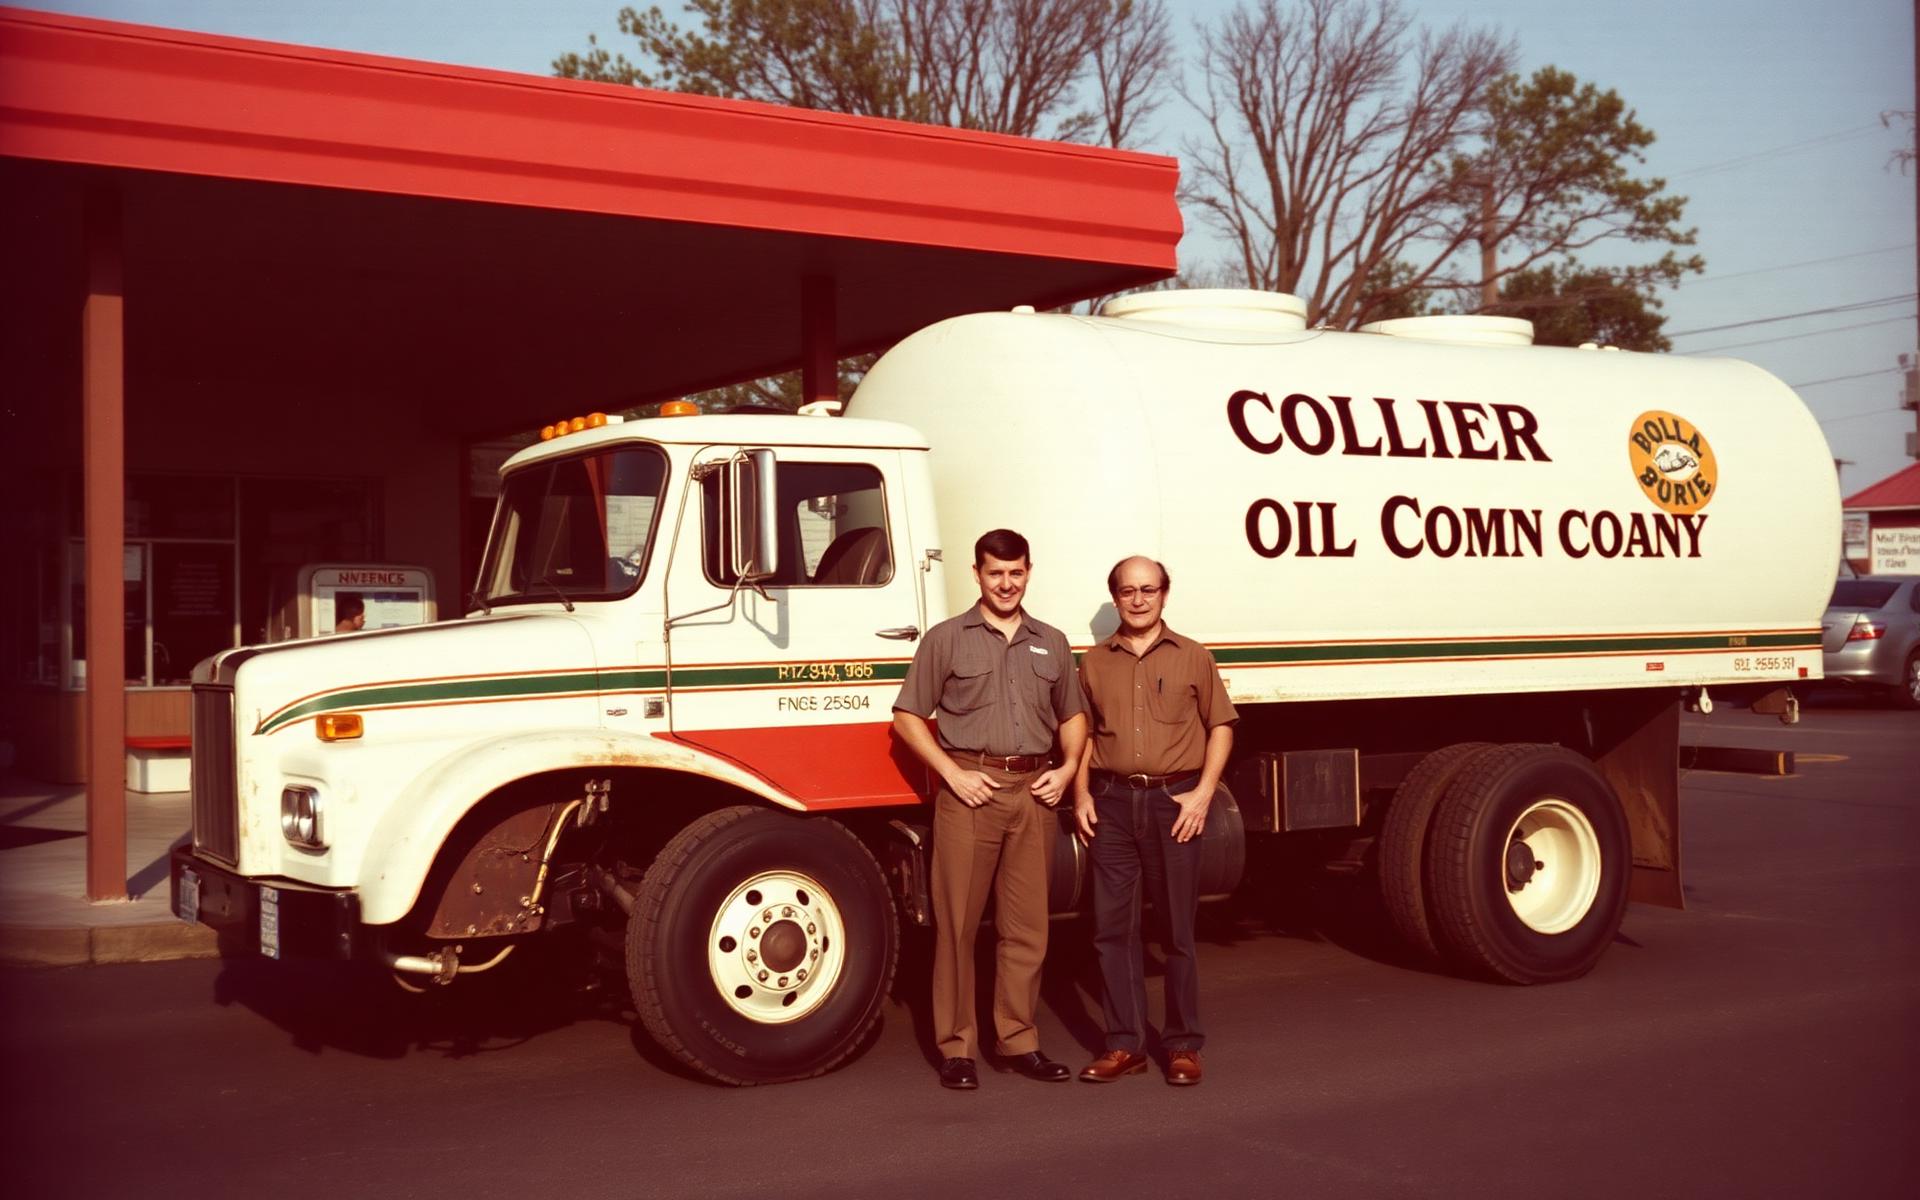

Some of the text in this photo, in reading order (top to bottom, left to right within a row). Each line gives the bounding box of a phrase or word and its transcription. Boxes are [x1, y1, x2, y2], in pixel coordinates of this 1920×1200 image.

[1227, 390, 1552, 462] COLLIER
[1640, 466, 1711, 506] BURIE
[1246, 495, 1708, 559] OIL COMN COANY
